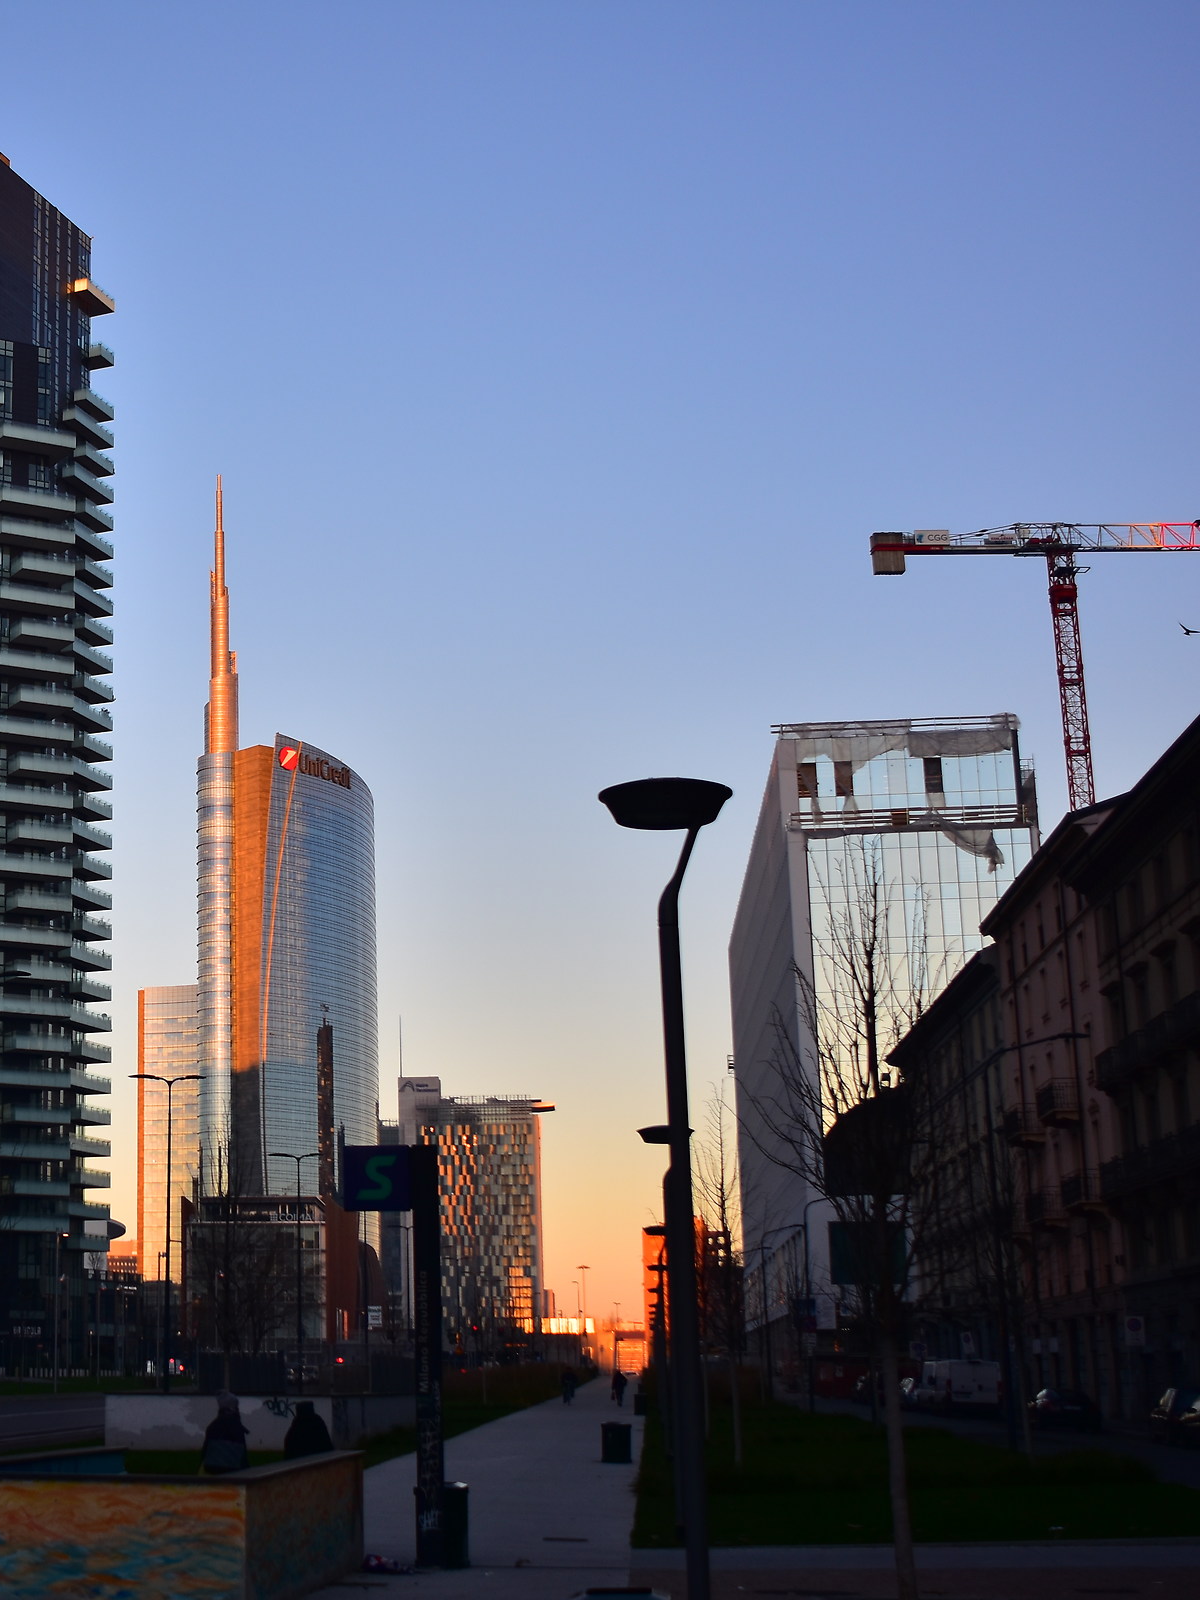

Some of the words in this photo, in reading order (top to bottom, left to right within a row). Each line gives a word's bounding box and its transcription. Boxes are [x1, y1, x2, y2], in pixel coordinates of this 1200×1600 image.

[298, 752, 352, 790] UniCredit
[356, 1155, 397, 1201] S
[416, 1270, 431, 1344] Repubblica
[417, 1347, 430, 1393] Milano
